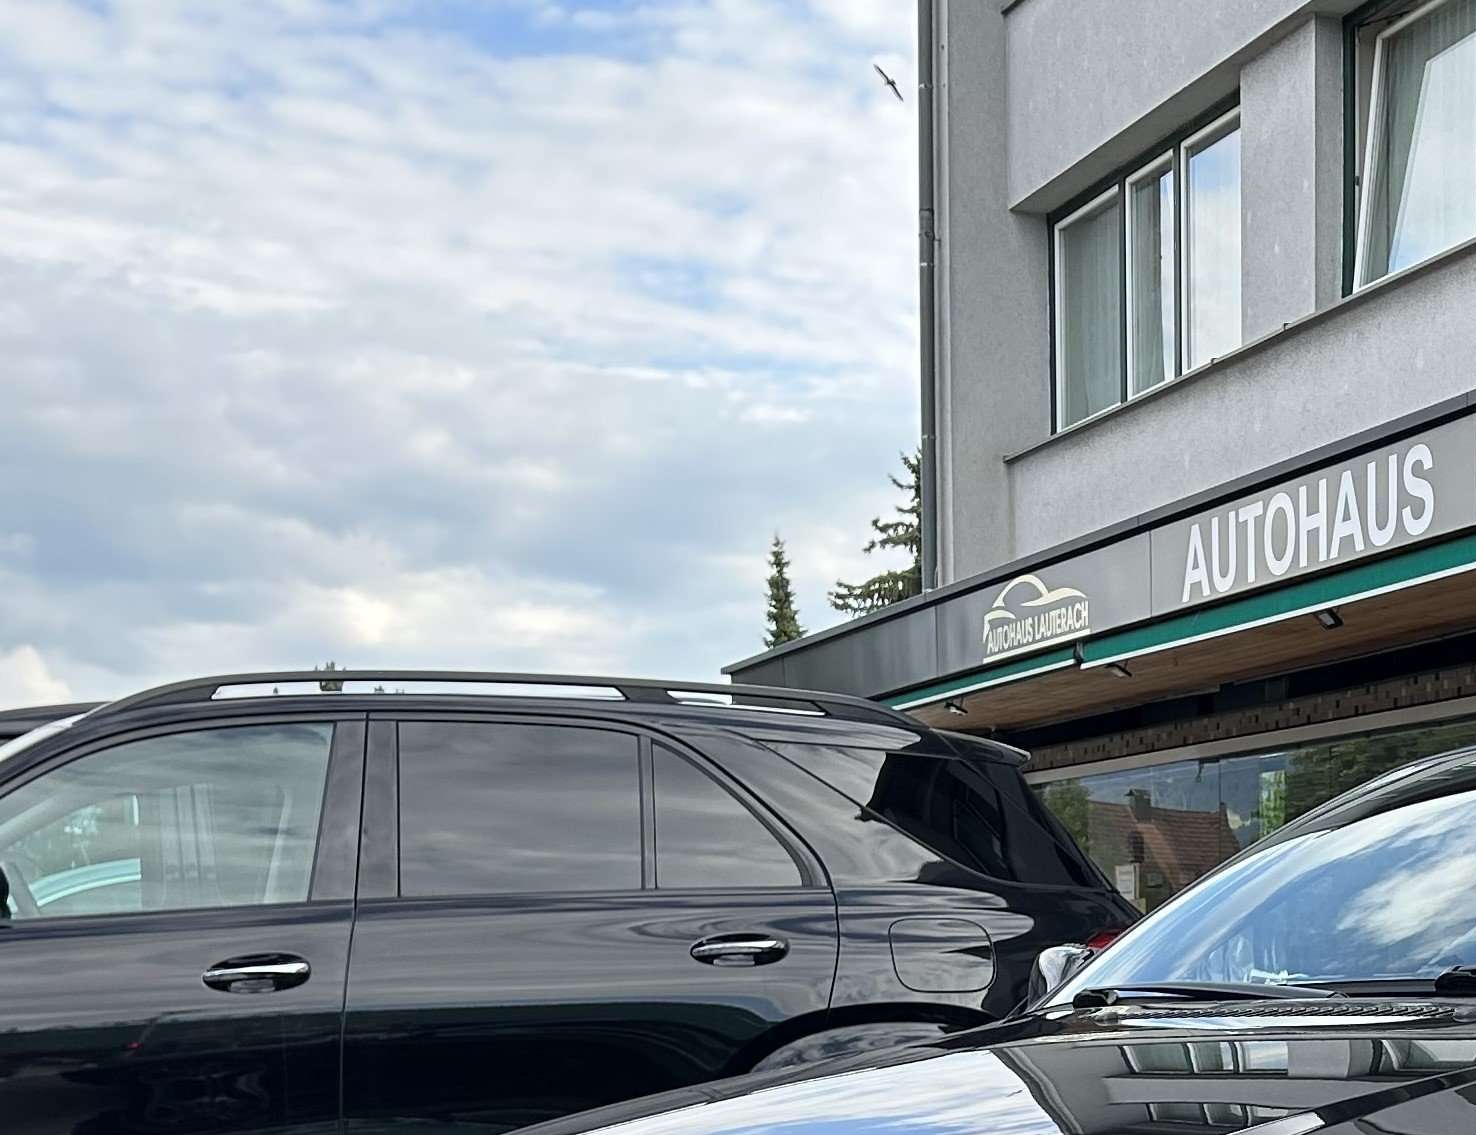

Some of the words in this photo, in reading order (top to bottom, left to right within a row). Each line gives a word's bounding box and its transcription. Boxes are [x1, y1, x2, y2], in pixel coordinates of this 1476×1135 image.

[1181, 443, 1435, 603] AUTOHAUS
[986, 616, 1033, 655] AUTOHAUS
[1034, 600, 1089, 640] LAUTERACH
